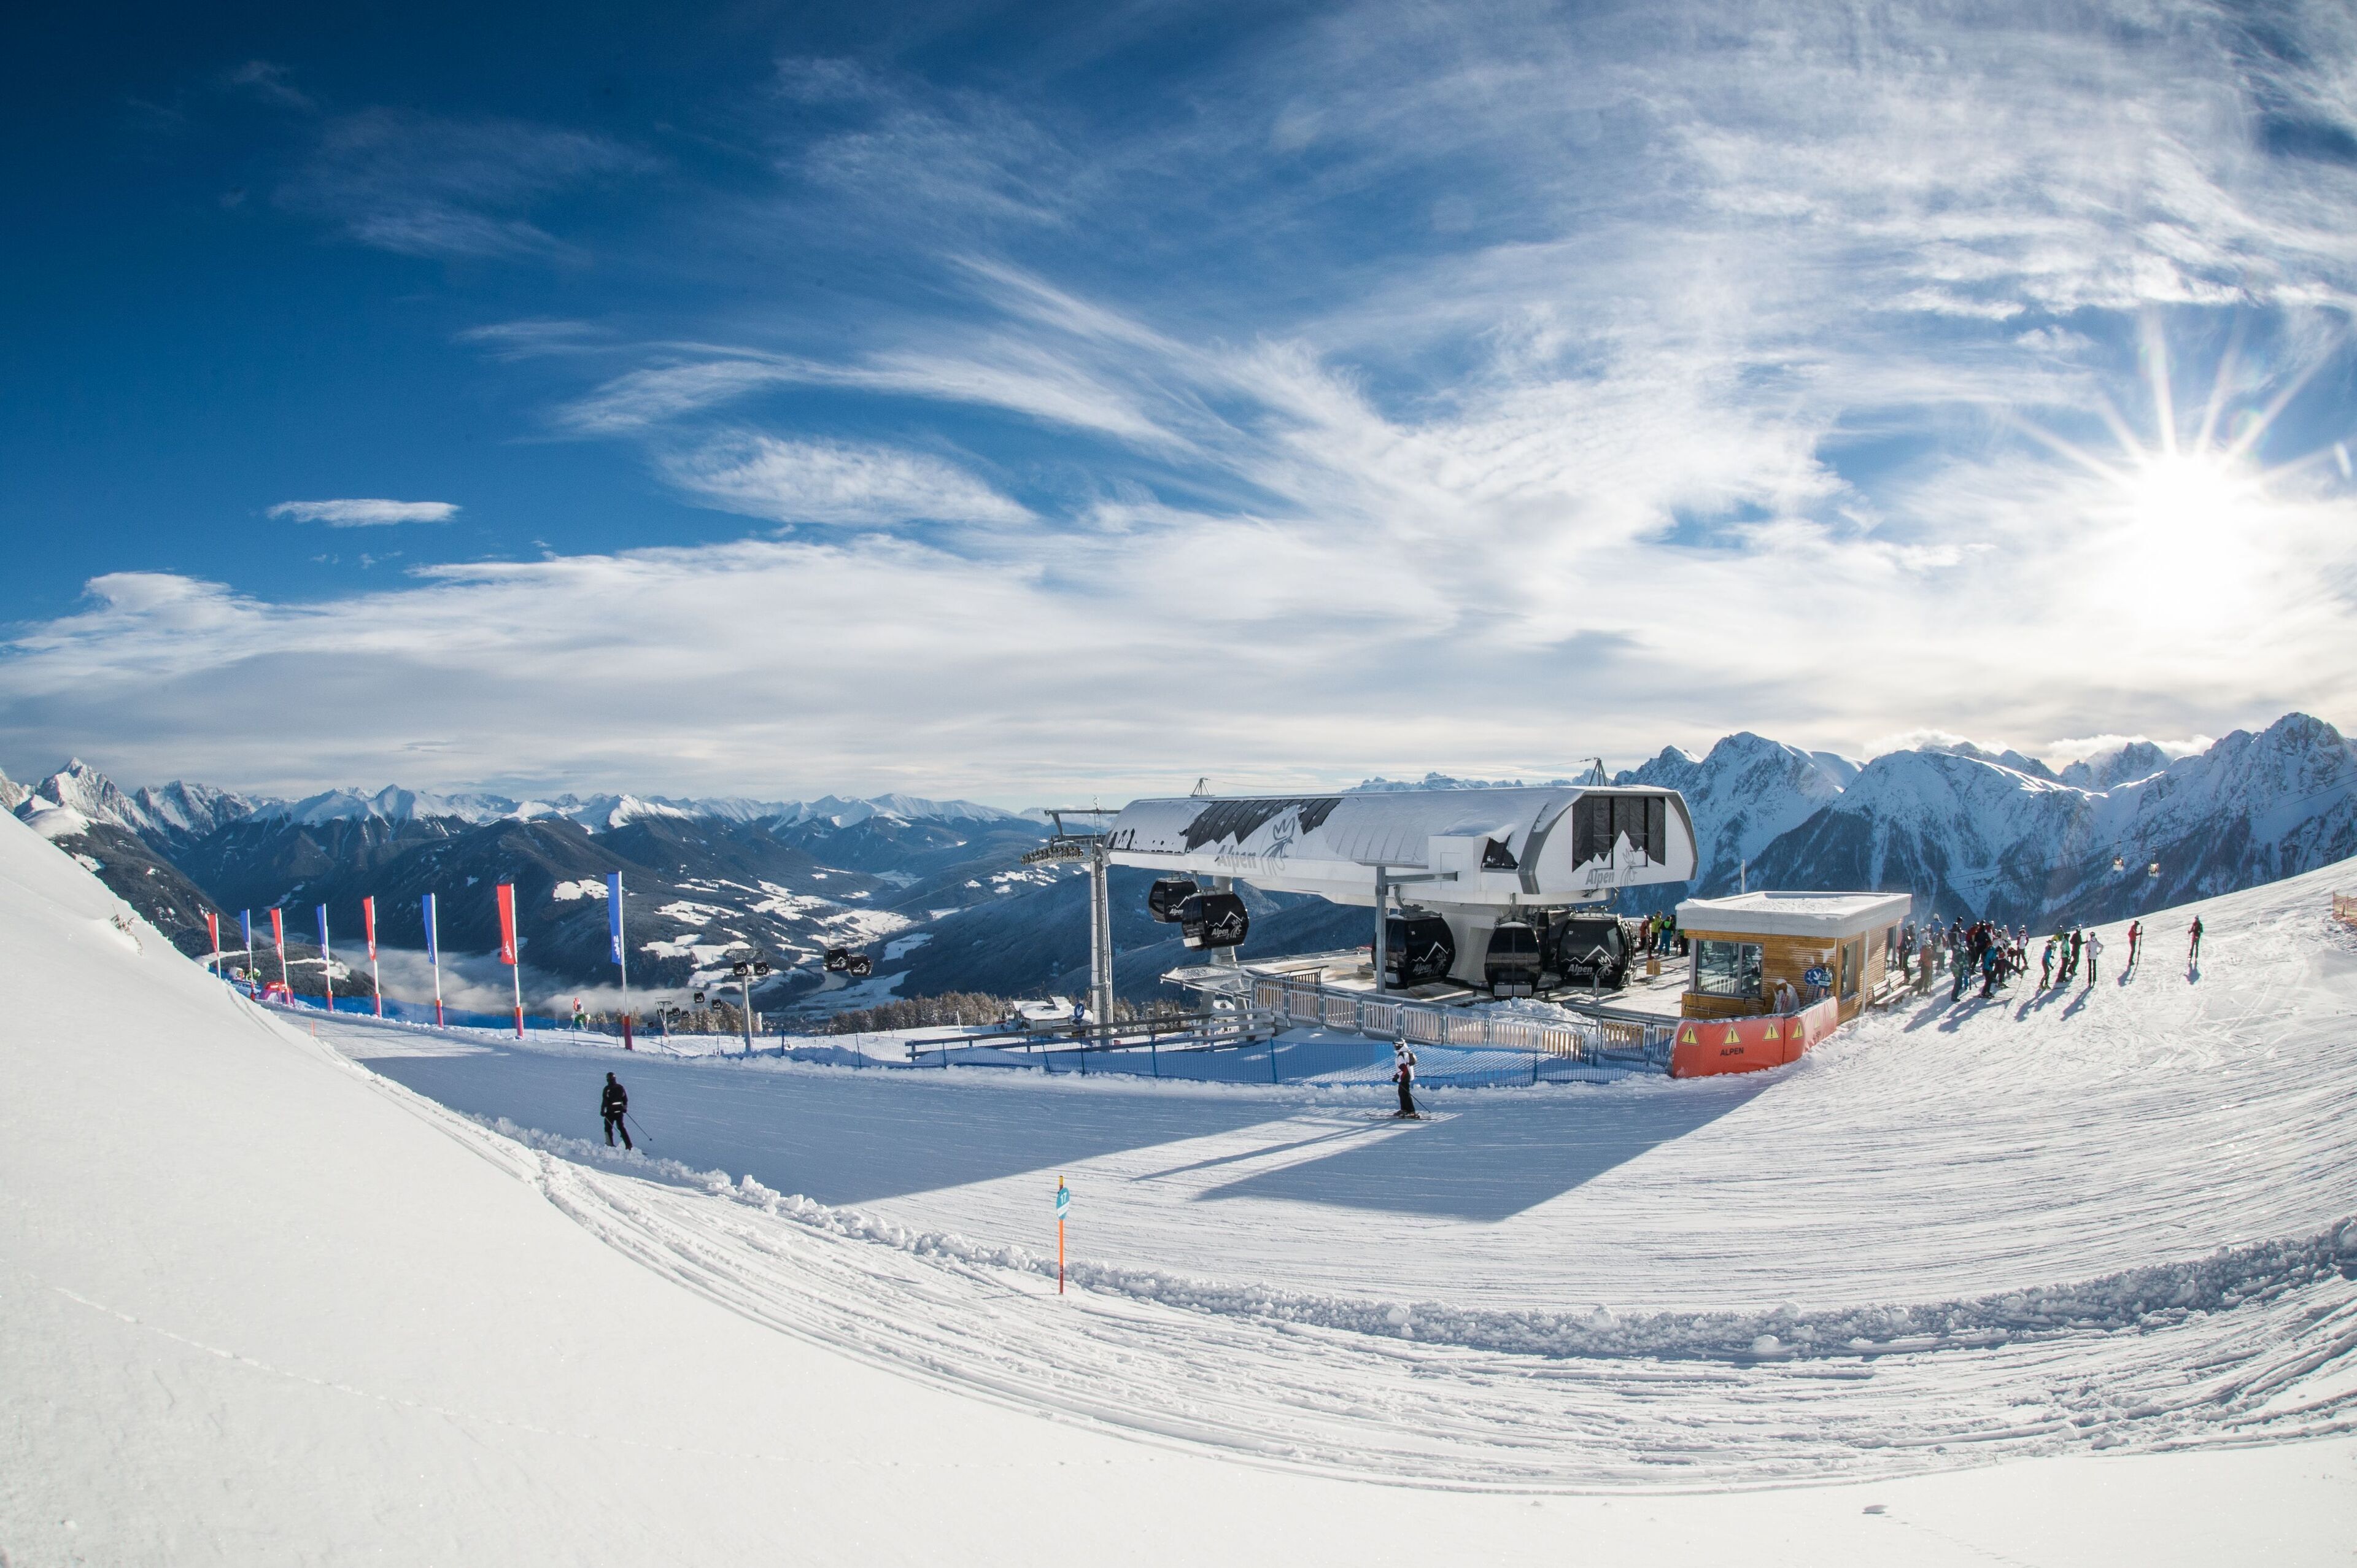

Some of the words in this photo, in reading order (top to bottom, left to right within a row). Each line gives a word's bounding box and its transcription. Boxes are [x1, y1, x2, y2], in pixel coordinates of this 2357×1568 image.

[1216, 845, 1256, 874] Alpen
[1585, 869, 1615, 888] Alpen
[1211, 928, 1229, 937] Alpen
[1412, 963, 1432, 975] Alpen
[1568, 964, 1593, 976] Alpen
[1720, 1047, 1744, 1056] ALPEN
[1060, 1192, 1067, 1205] 17
